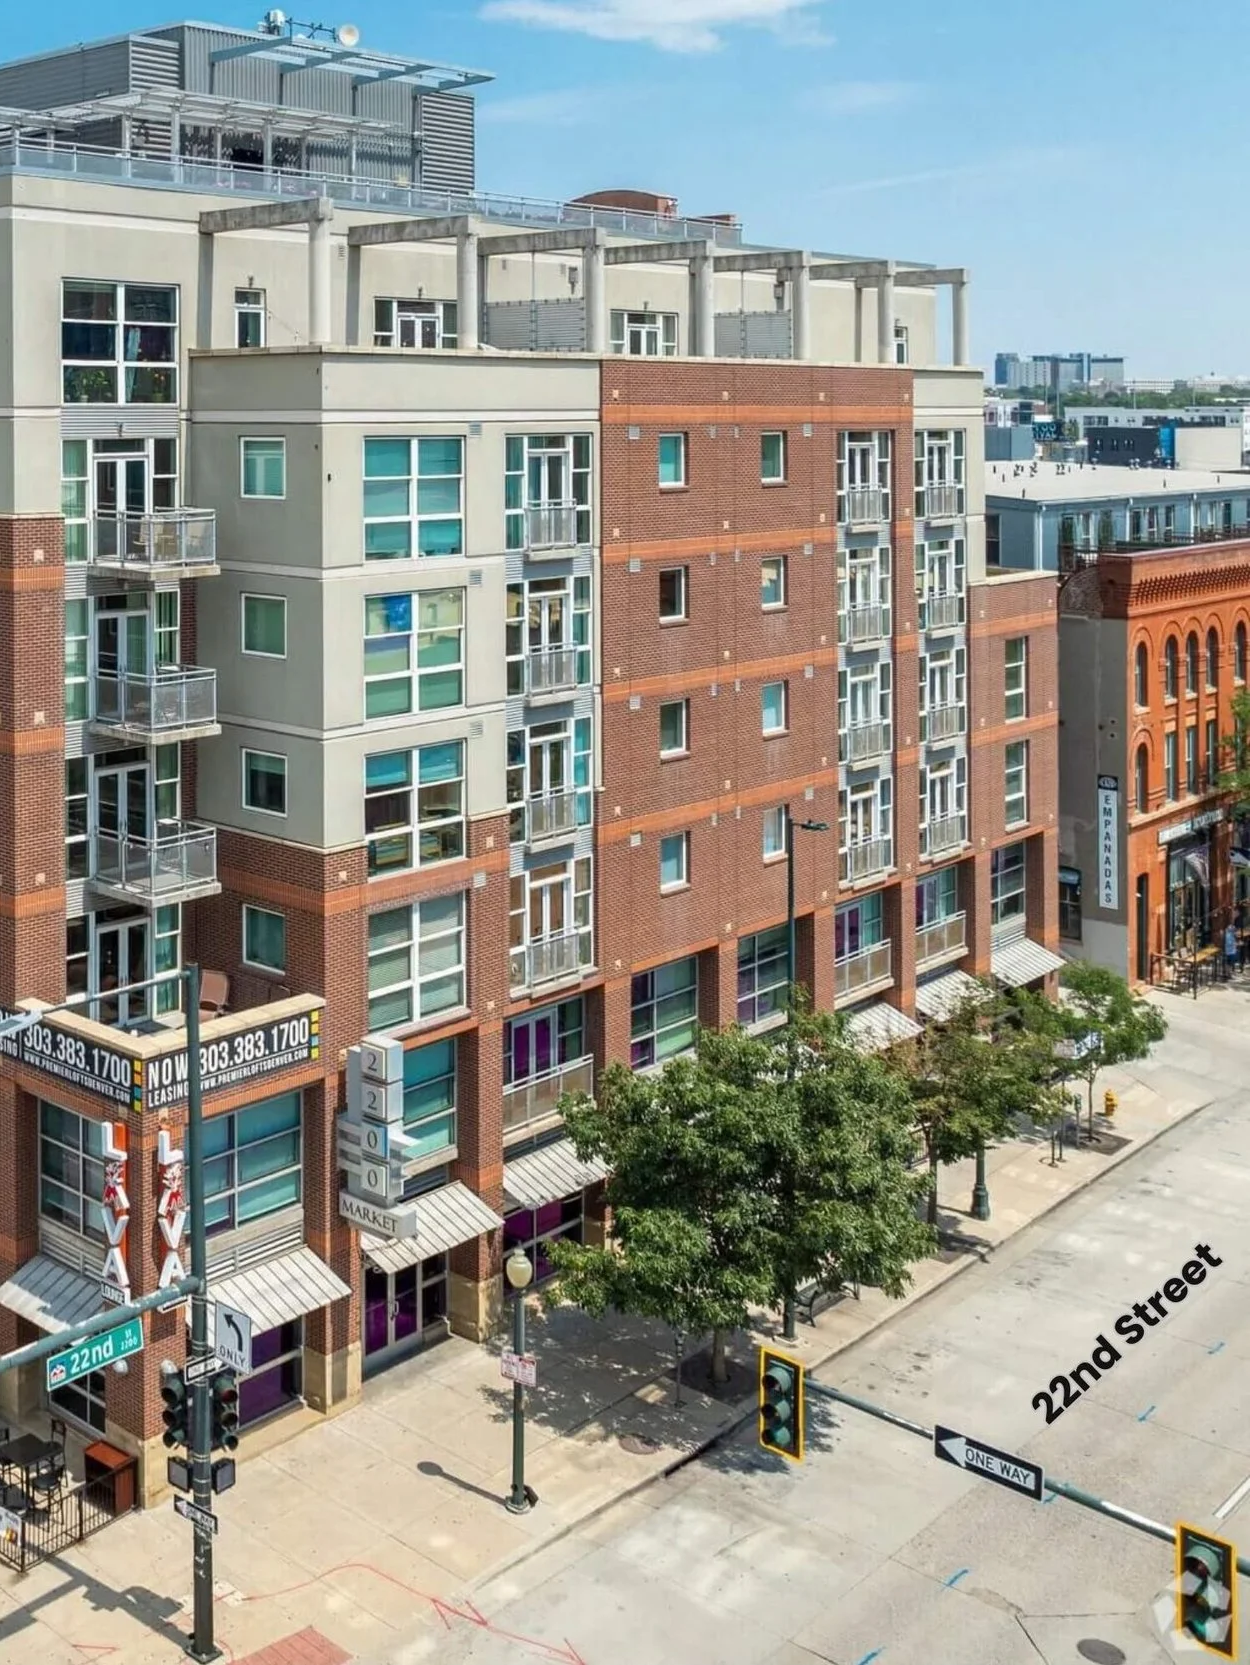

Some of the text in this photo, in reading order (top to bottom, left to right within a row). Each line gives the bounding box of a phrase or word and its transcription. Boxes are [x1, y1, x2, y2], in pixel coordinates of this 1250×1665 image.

[1102, 795, 1112, 904] EMPANADAS
[24, 1023, 132, 1088] 303.383.1700
[148, 1052, 189, 1090] NOW
[341, 1199, 398, 1234] MARKET
[70, 1334, 114, 1375] 22nd
[219, 1344, 246, 1368] ONLY
[965, 1447, 1031, 1485] ONE WAY
